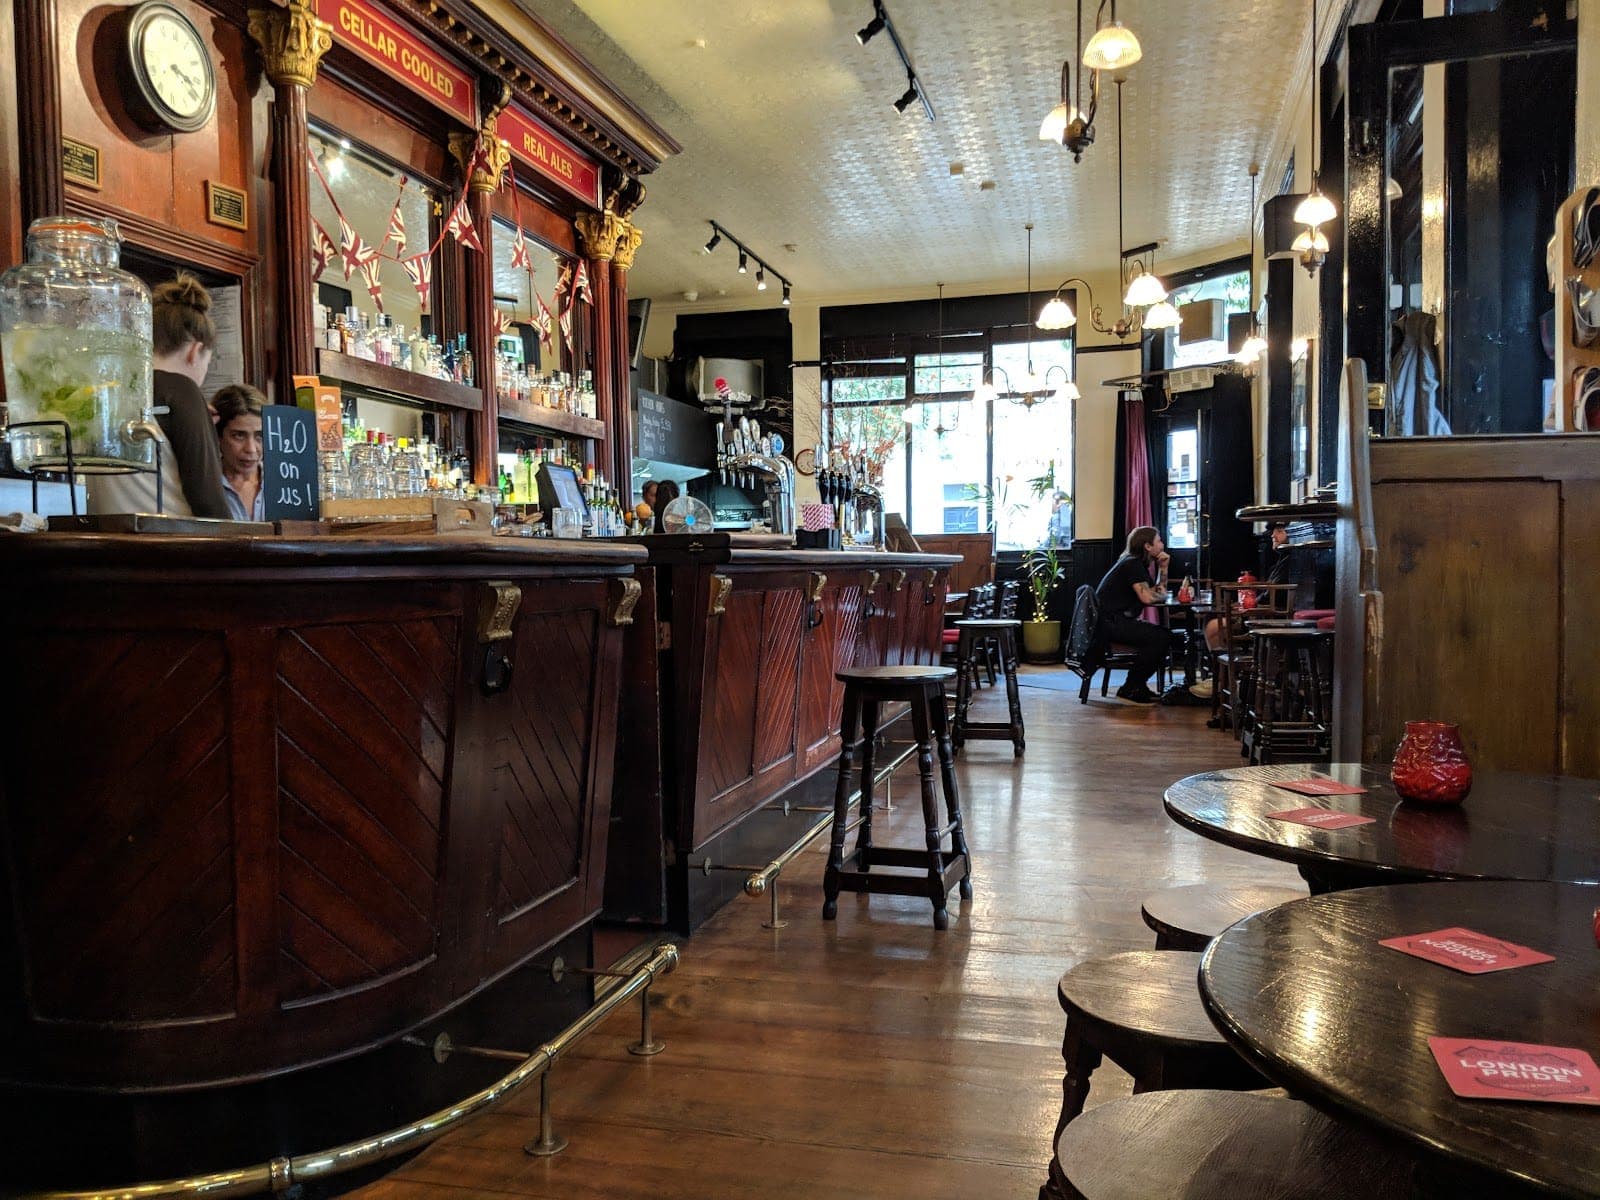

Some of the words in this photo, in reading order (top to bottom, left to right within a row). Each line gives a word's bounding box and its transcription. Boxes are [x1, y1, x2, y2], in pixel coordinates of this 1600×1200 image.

[339, 6, 398, 63] CELLAR
[401, 48, 455, 99] COOLED
[523, 132, 549, 163] REAL
[550, 152, 573, 180] ALES
[1459, 1059, 1583, 1077] LONDON
[1481, 1068, 1572, 1084] PRIDE
